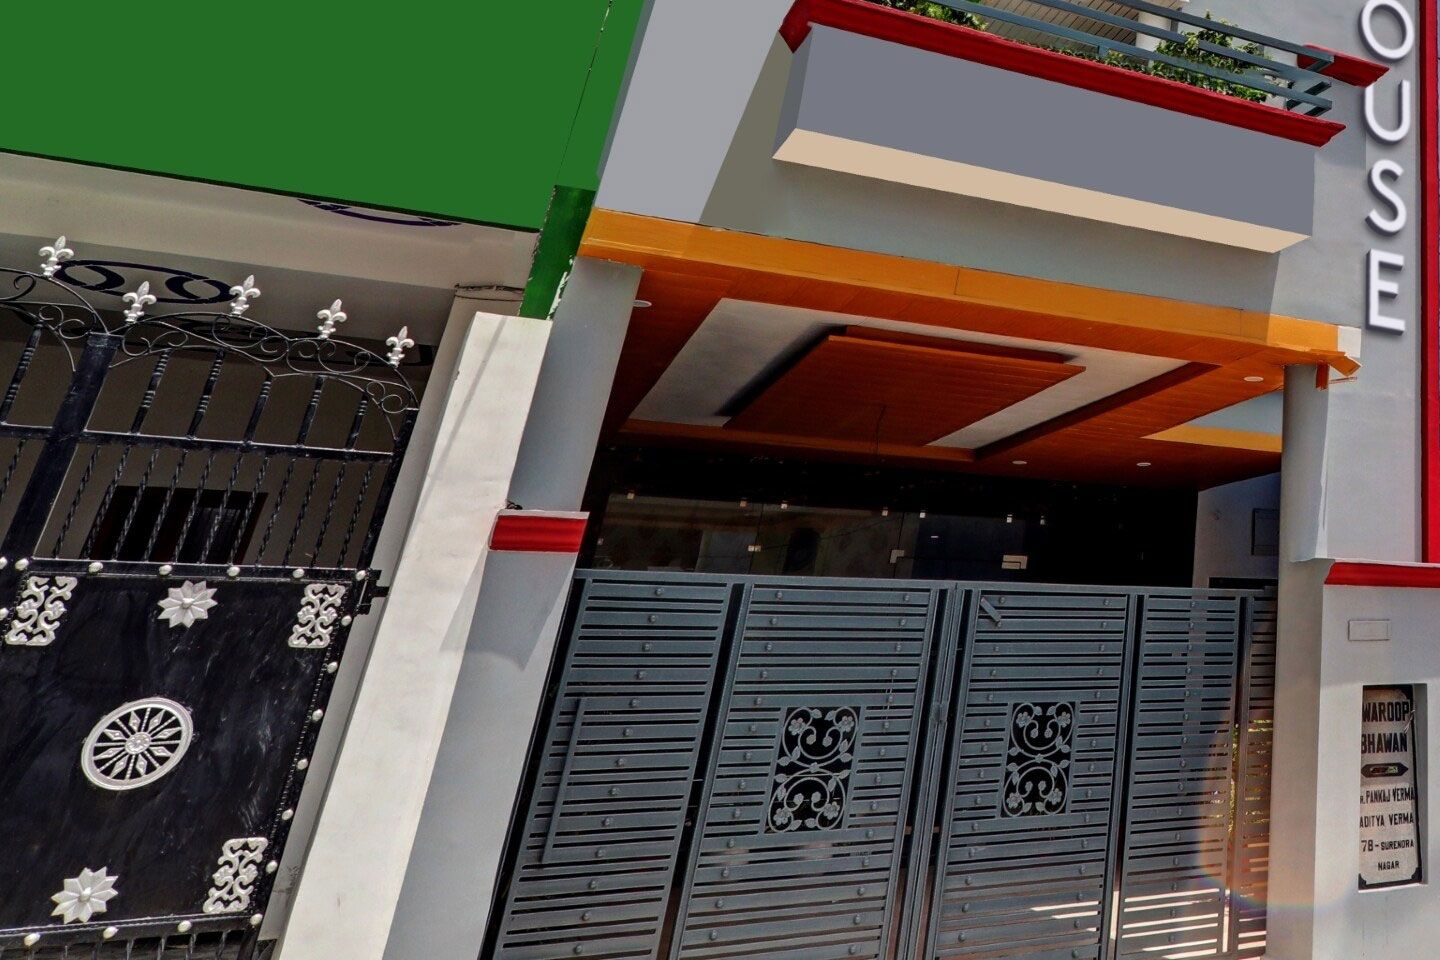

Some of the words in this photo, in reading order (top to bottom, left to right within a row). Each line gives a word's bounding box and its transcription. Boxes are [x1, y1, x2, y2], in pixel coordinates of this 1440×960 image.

[1392, 786, 1415, 802] VERMA
[1360, 815, 1385, 828] ADITYA
[1389, 812, 1415, 826] VERMA
[1378, 860, 1400, 871] NAGAR
